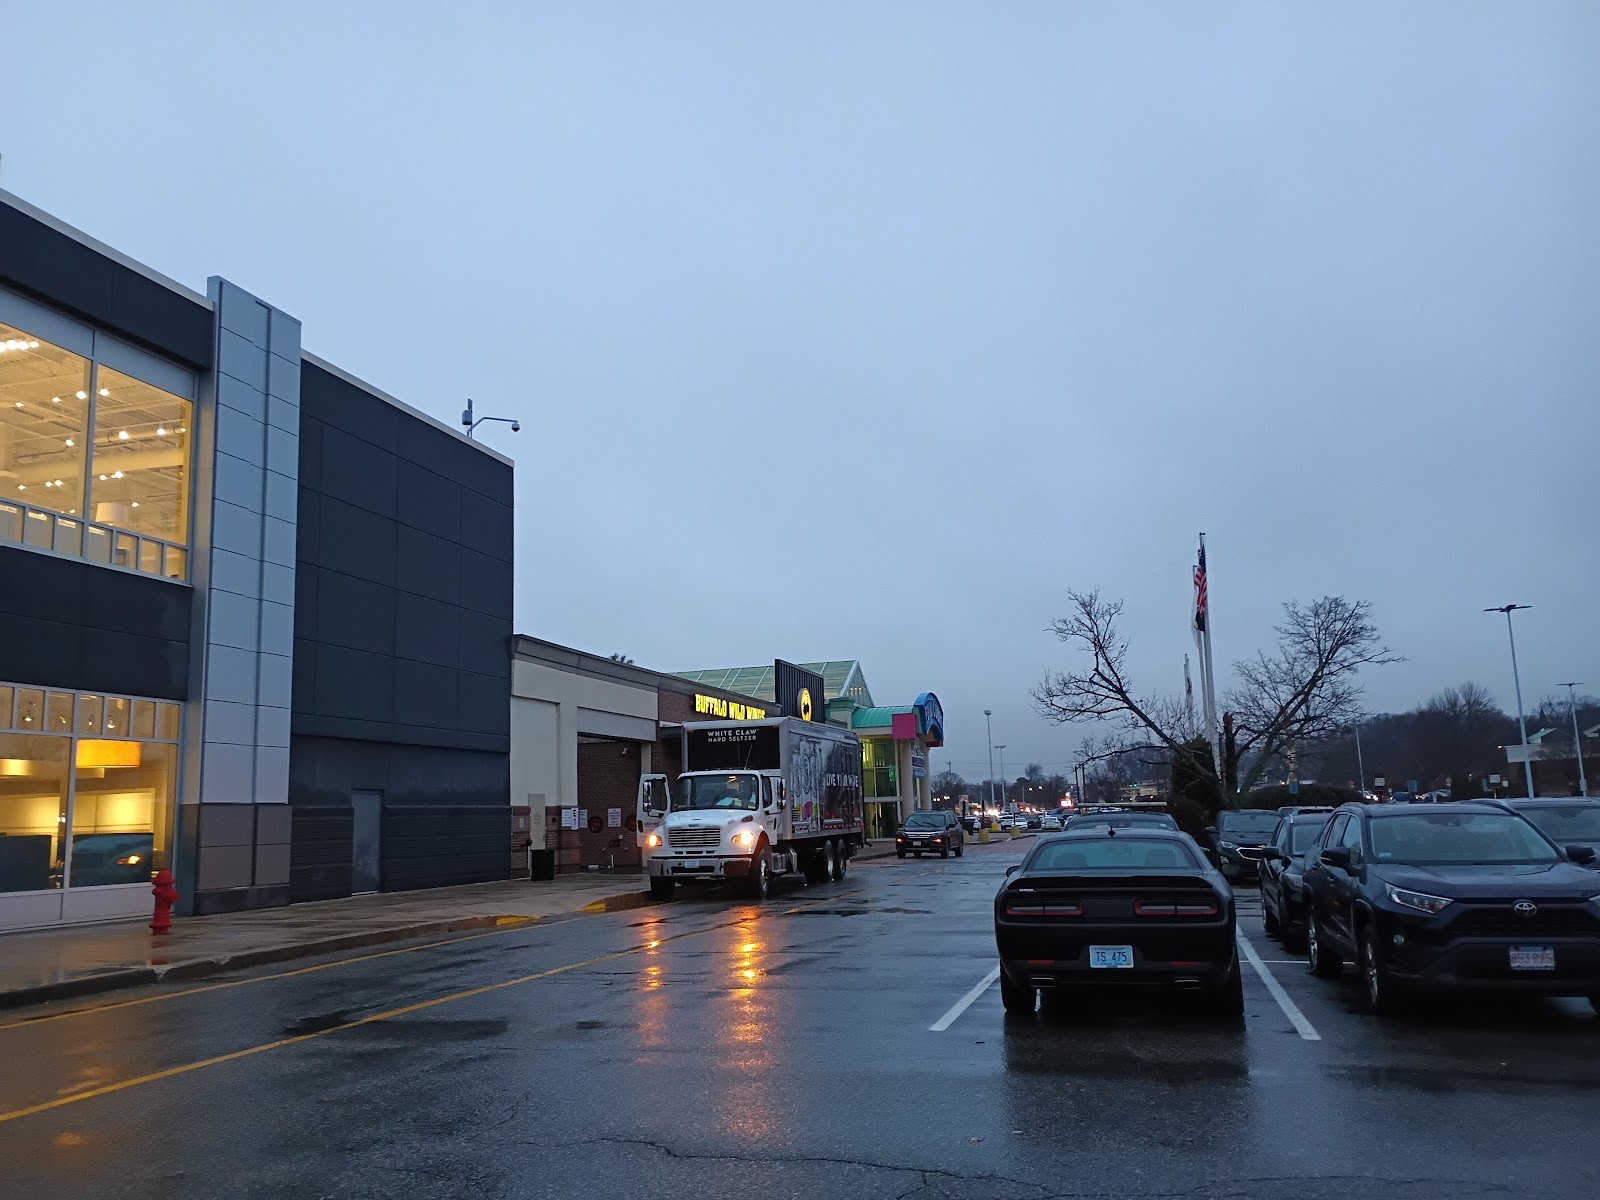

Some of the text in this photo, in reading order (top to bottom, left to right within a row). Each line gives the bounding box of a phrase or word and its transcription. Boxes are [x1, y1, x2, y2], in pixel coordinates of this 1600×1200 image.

[695, 694, 765, 720] BUFFALO WILD WINGS
[1095, 951, 1127, 962] TS 475
